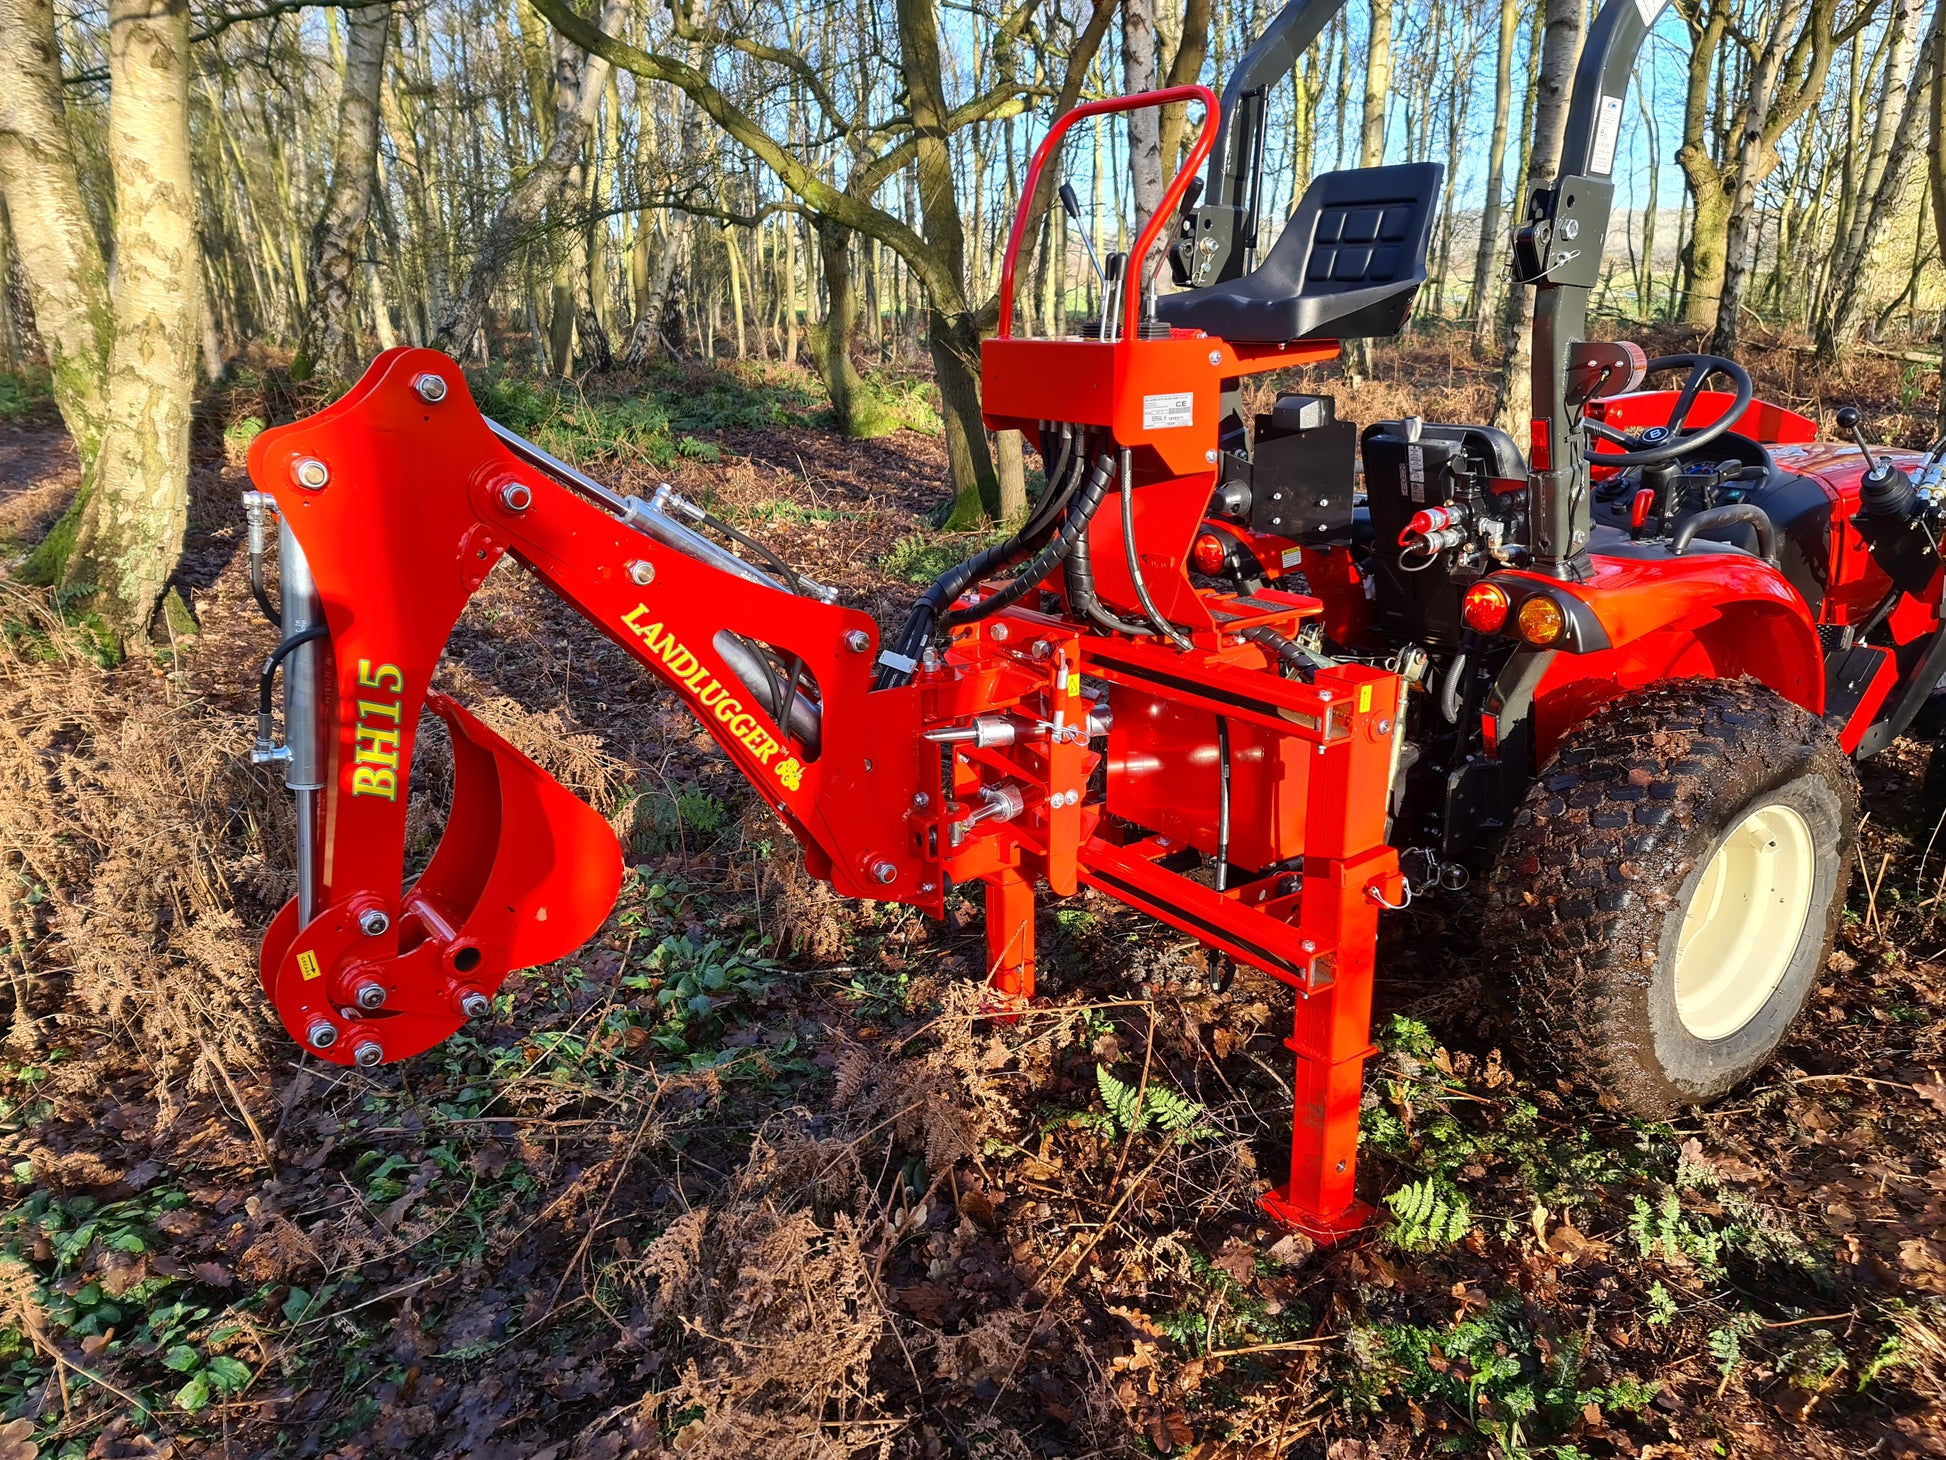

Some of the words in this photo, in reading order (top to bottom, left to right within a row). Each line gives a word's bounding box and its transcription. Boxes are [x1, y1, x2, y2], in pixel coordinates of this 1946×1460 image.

[1650, 429, 1661, 439] B
[352, 658, 404, 802] BH15
[621, 602, 780, 765] LANDLUGGER
